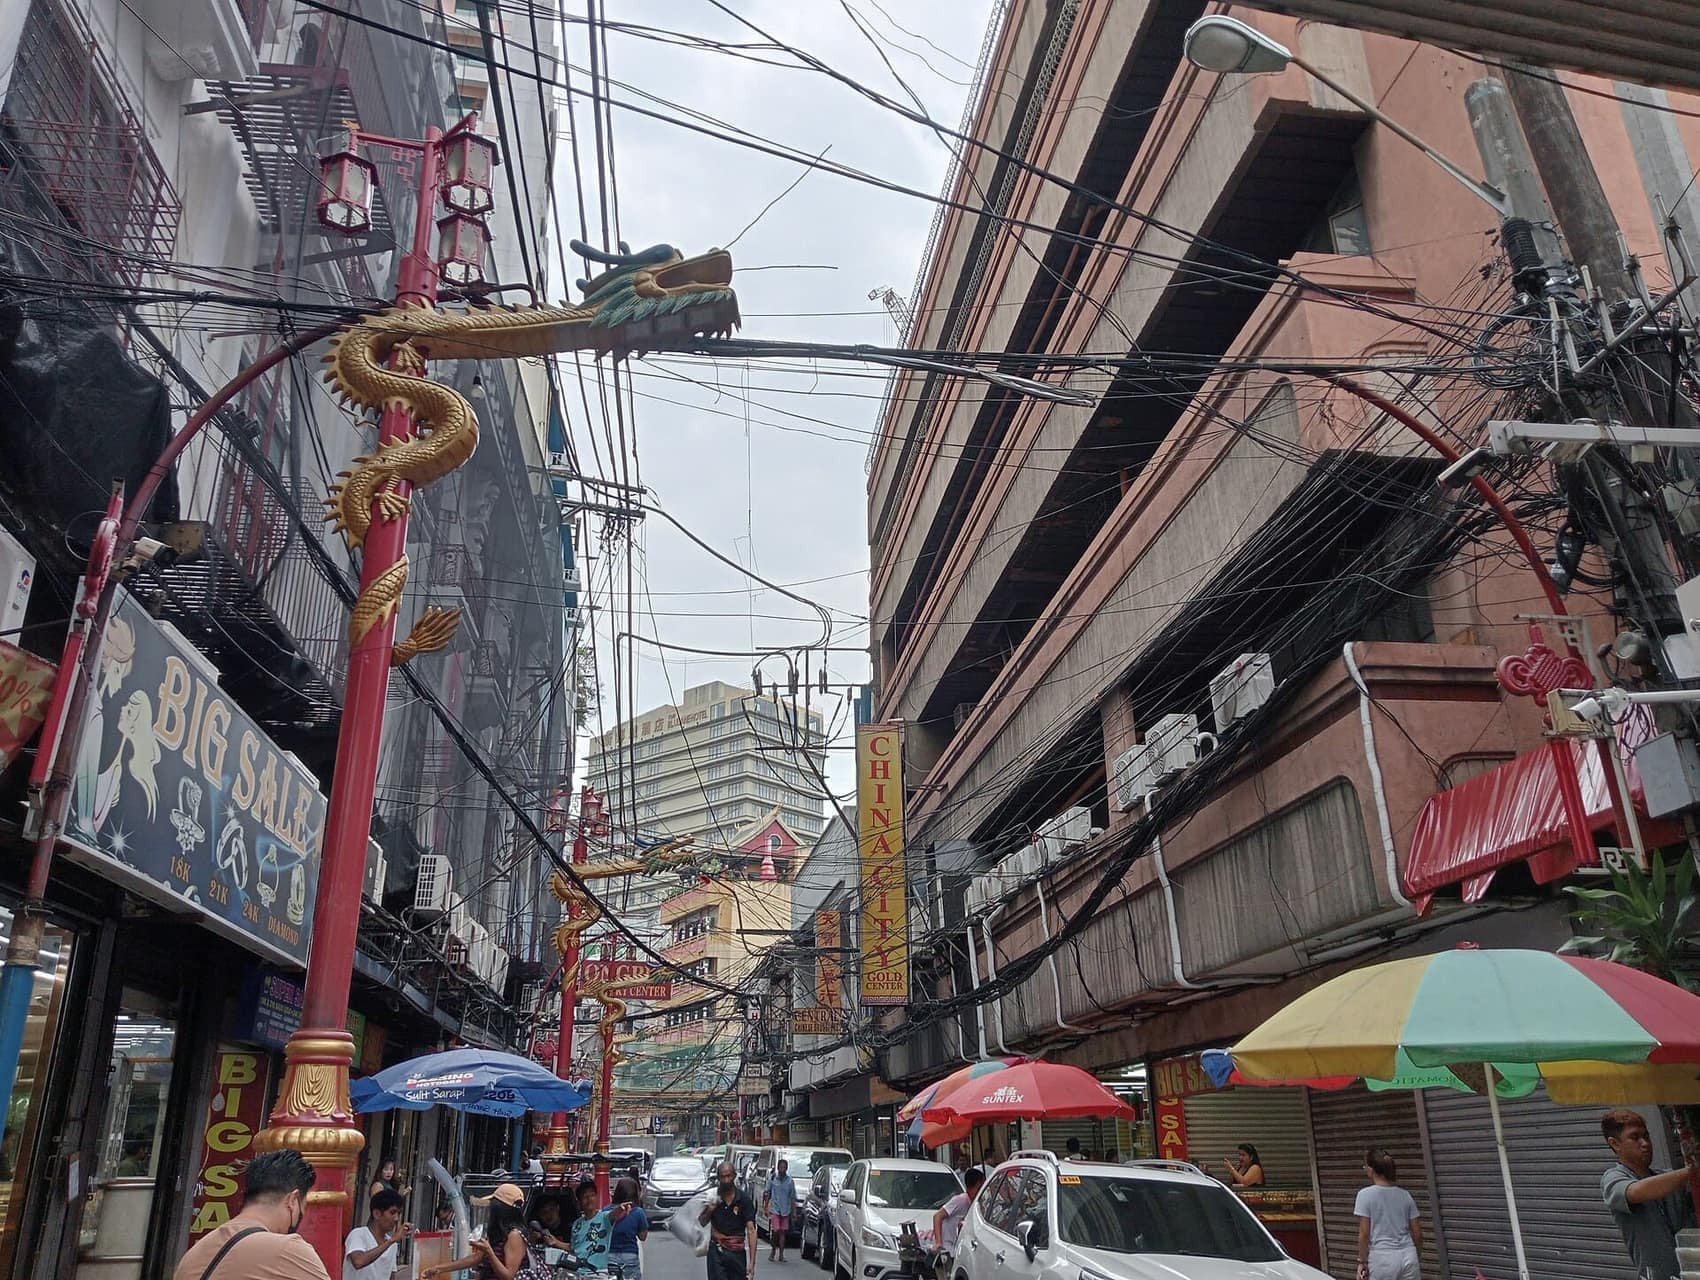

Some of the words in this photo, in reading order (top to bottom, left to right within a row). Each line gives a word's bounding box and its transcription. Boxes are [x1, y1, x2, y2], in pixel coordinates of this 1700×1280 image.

[153, 656, 231, 791] BIG
[232, 730, 312, 859] SALE
[869, 736, 893, 855] CHINA
[170, 856, 191, 883] 18K
[209, 880, 229, 905] 21K
[243, 900, 260, 924] 24K
[268, 916, 299, 946] DIAMOND
[871, 866, 894, 967] CITY
[629, 986, 666, 997] CENTER
[866, 972, 903, 982] GOLD
[866, 982, 903, 991] CENTER
[206, 1054, 257, 1152] BIG
[982, 1094, 1024, 1104] SUNTEX
[1154, 1061, 1184, 1097] BIG
[1161, 1115, 1183, 1170] SAL
